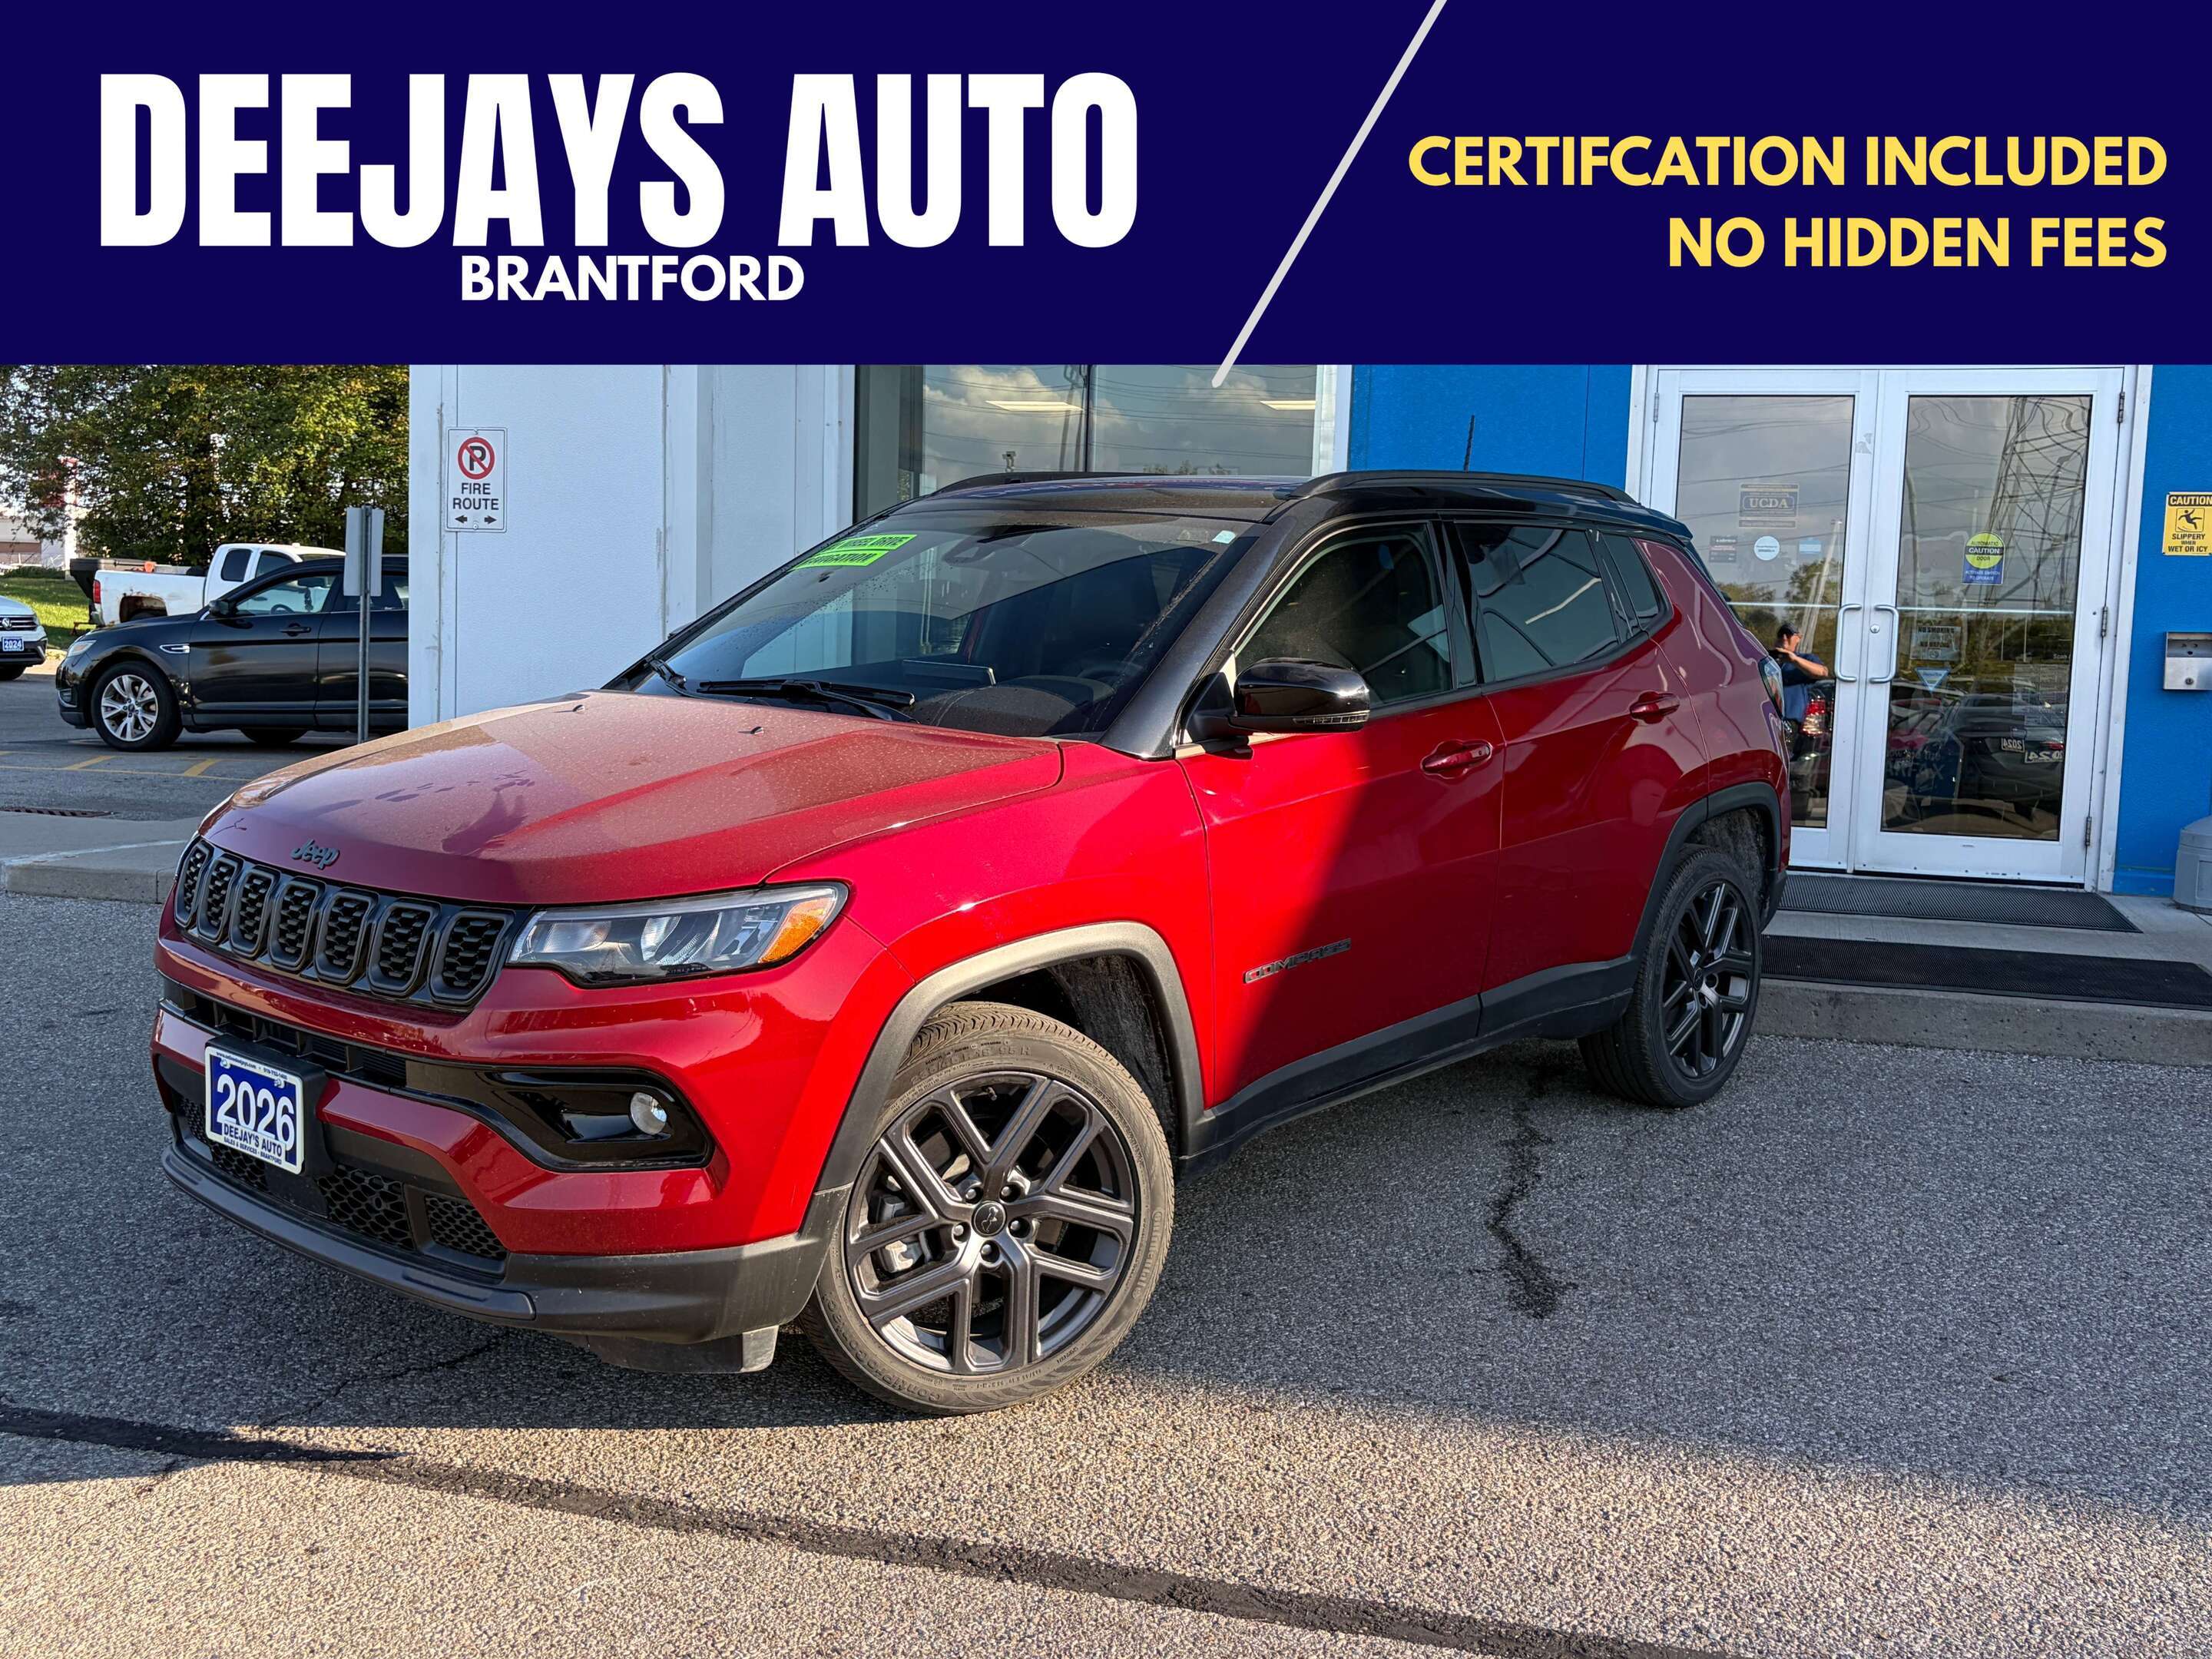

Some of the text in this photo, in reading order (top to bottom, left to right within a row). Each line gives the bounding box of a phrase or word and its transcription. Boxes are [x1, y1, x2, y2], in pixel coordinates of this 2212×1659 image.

[461, 482, 491, 495] FIRE
[452, 497, 499, 510] ROUTE
[1750, 498, 1789, 508] UCDA
[2170, 495, 2212, 505] CAUTION
[5, 639, 22, 649] 2024
[290, 838, 340, 870] Jeep
[217, 1074, 295, 1151] 2026
[224, 1123, 282, 1157] DEEJAY'S AUTO
[224, 1137, 235, 1147] SALES
[260, 1151, 283, 1165] BRANTFORD
